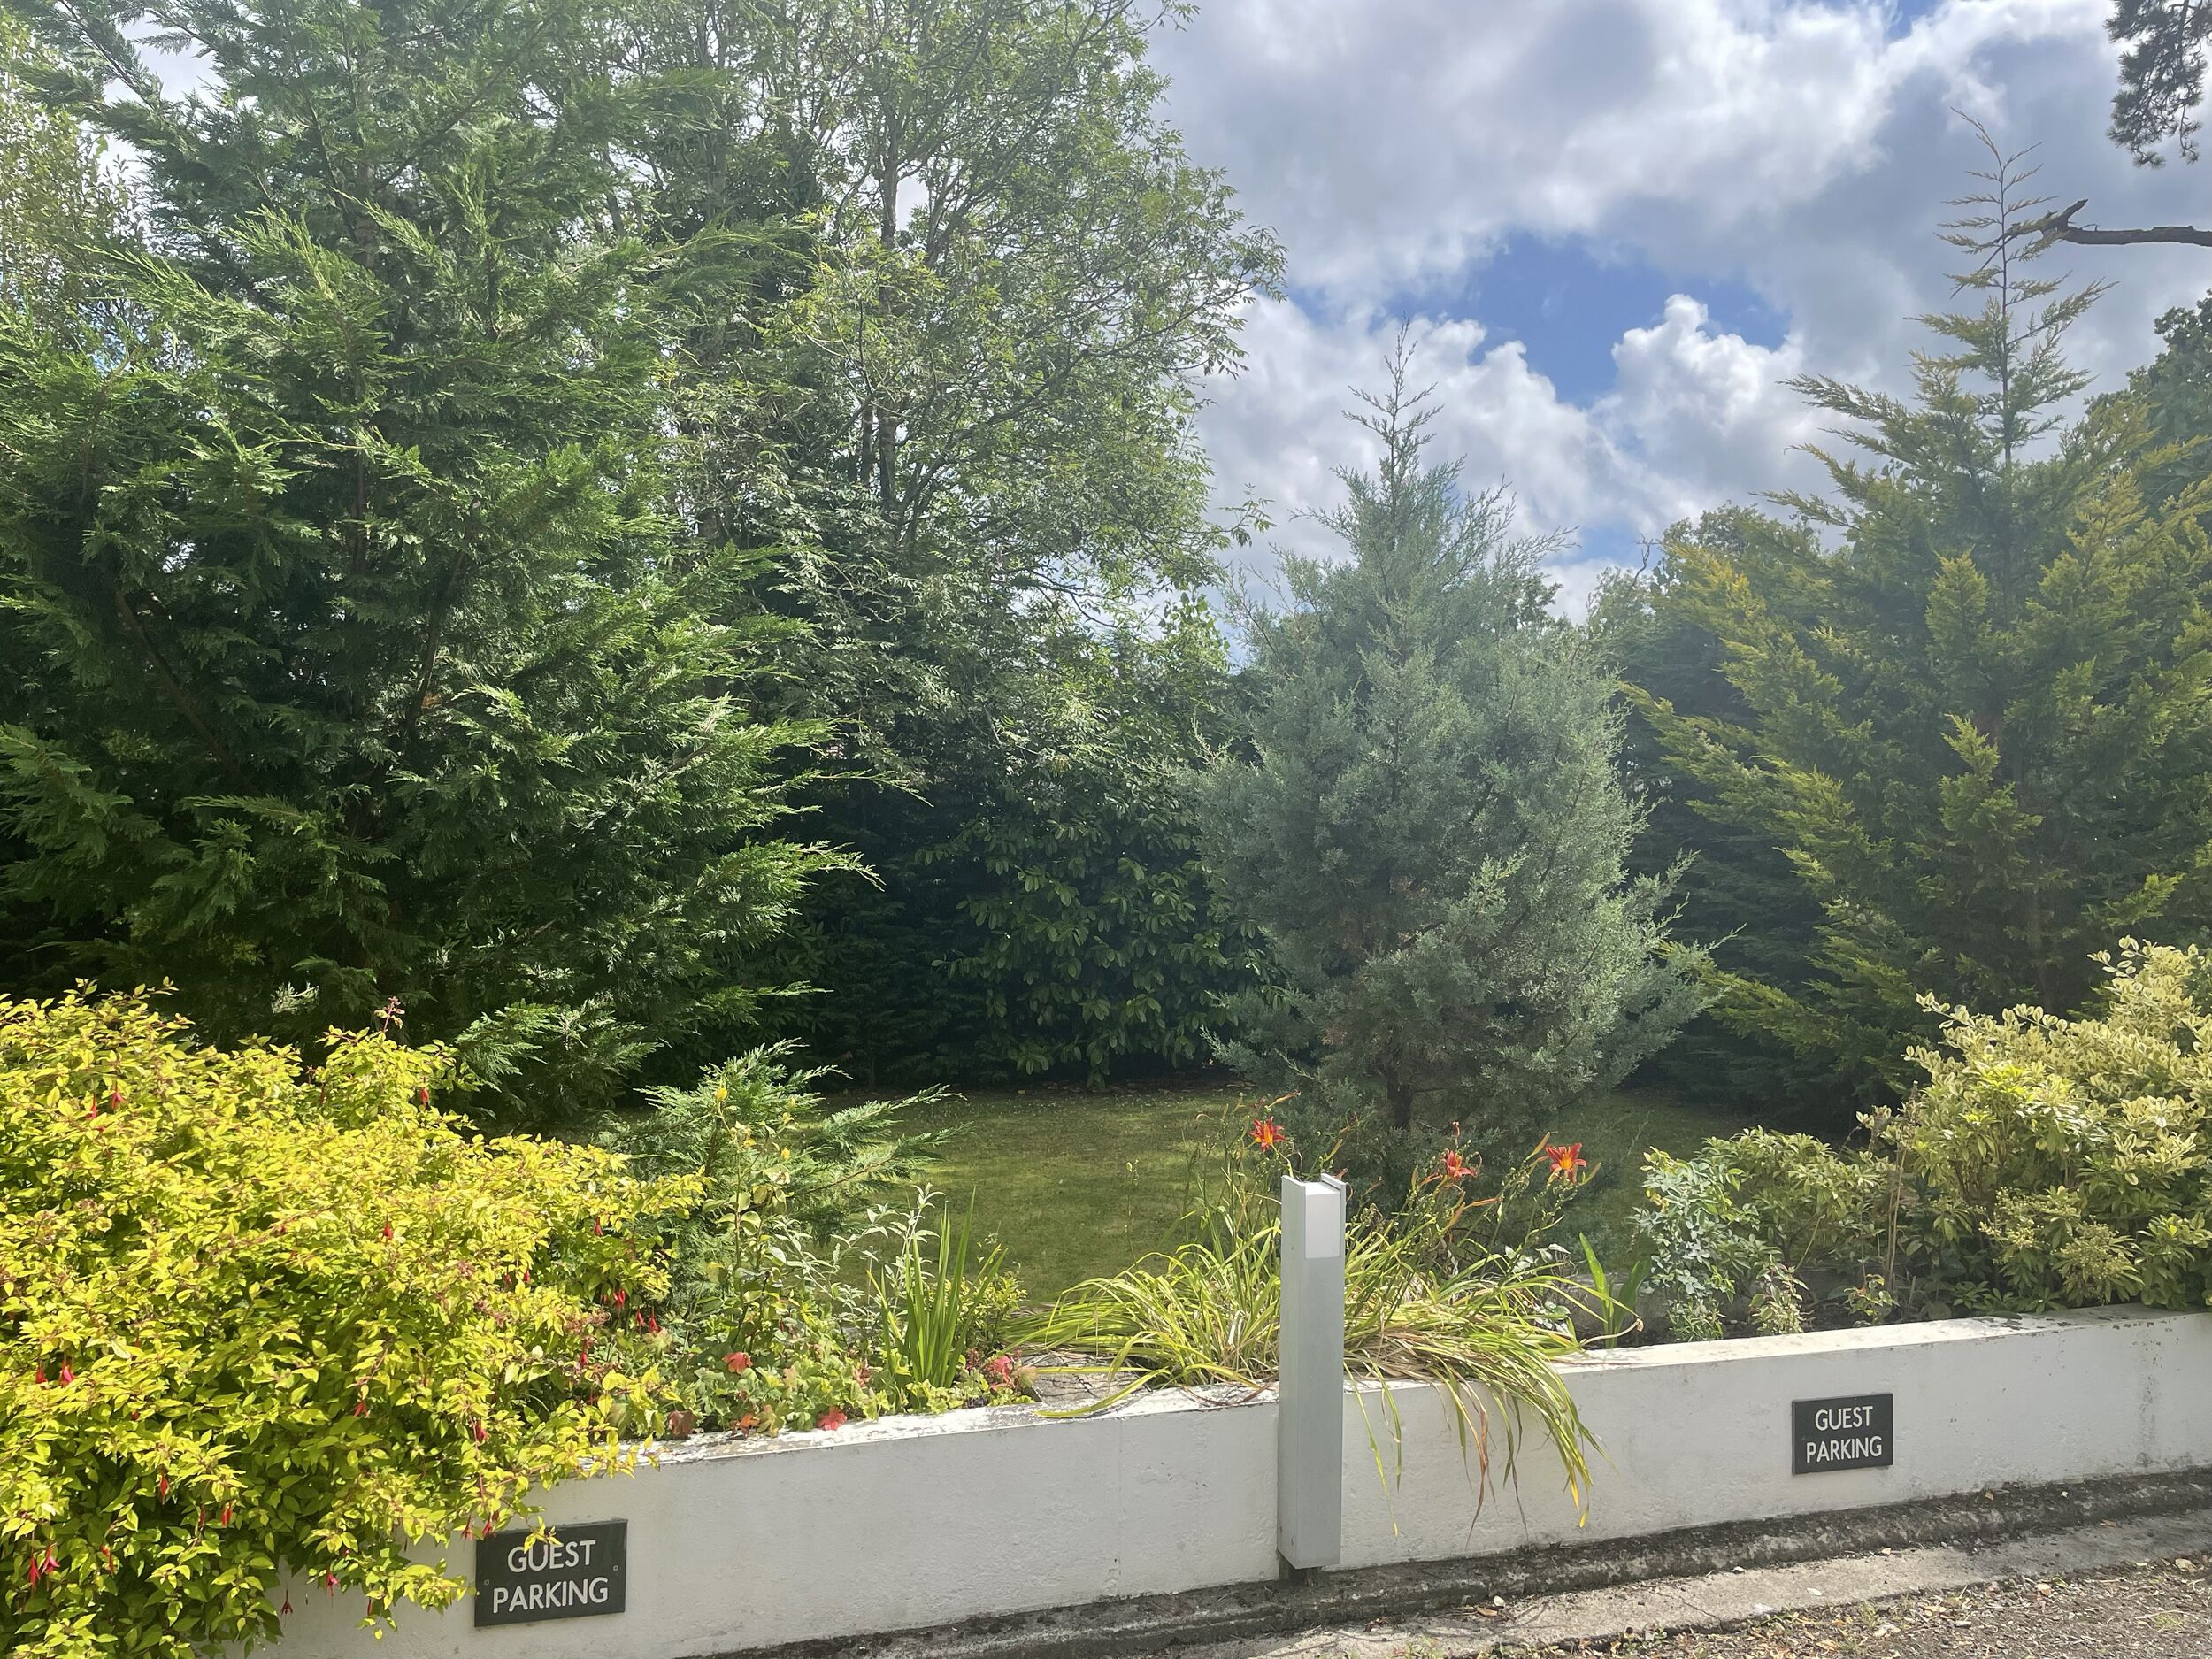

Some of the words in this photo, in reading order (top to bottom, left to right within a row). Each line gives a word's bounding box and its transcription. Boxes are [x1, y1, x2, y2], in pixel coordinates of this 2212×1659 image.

[1815, 1405, 1873, 1431] GUEST
[1806, 1435, 1883, 1463] PARKING
[507, 1539, 596, 1573] GUEST
[493, 1576, 609, 1614] PARKING
